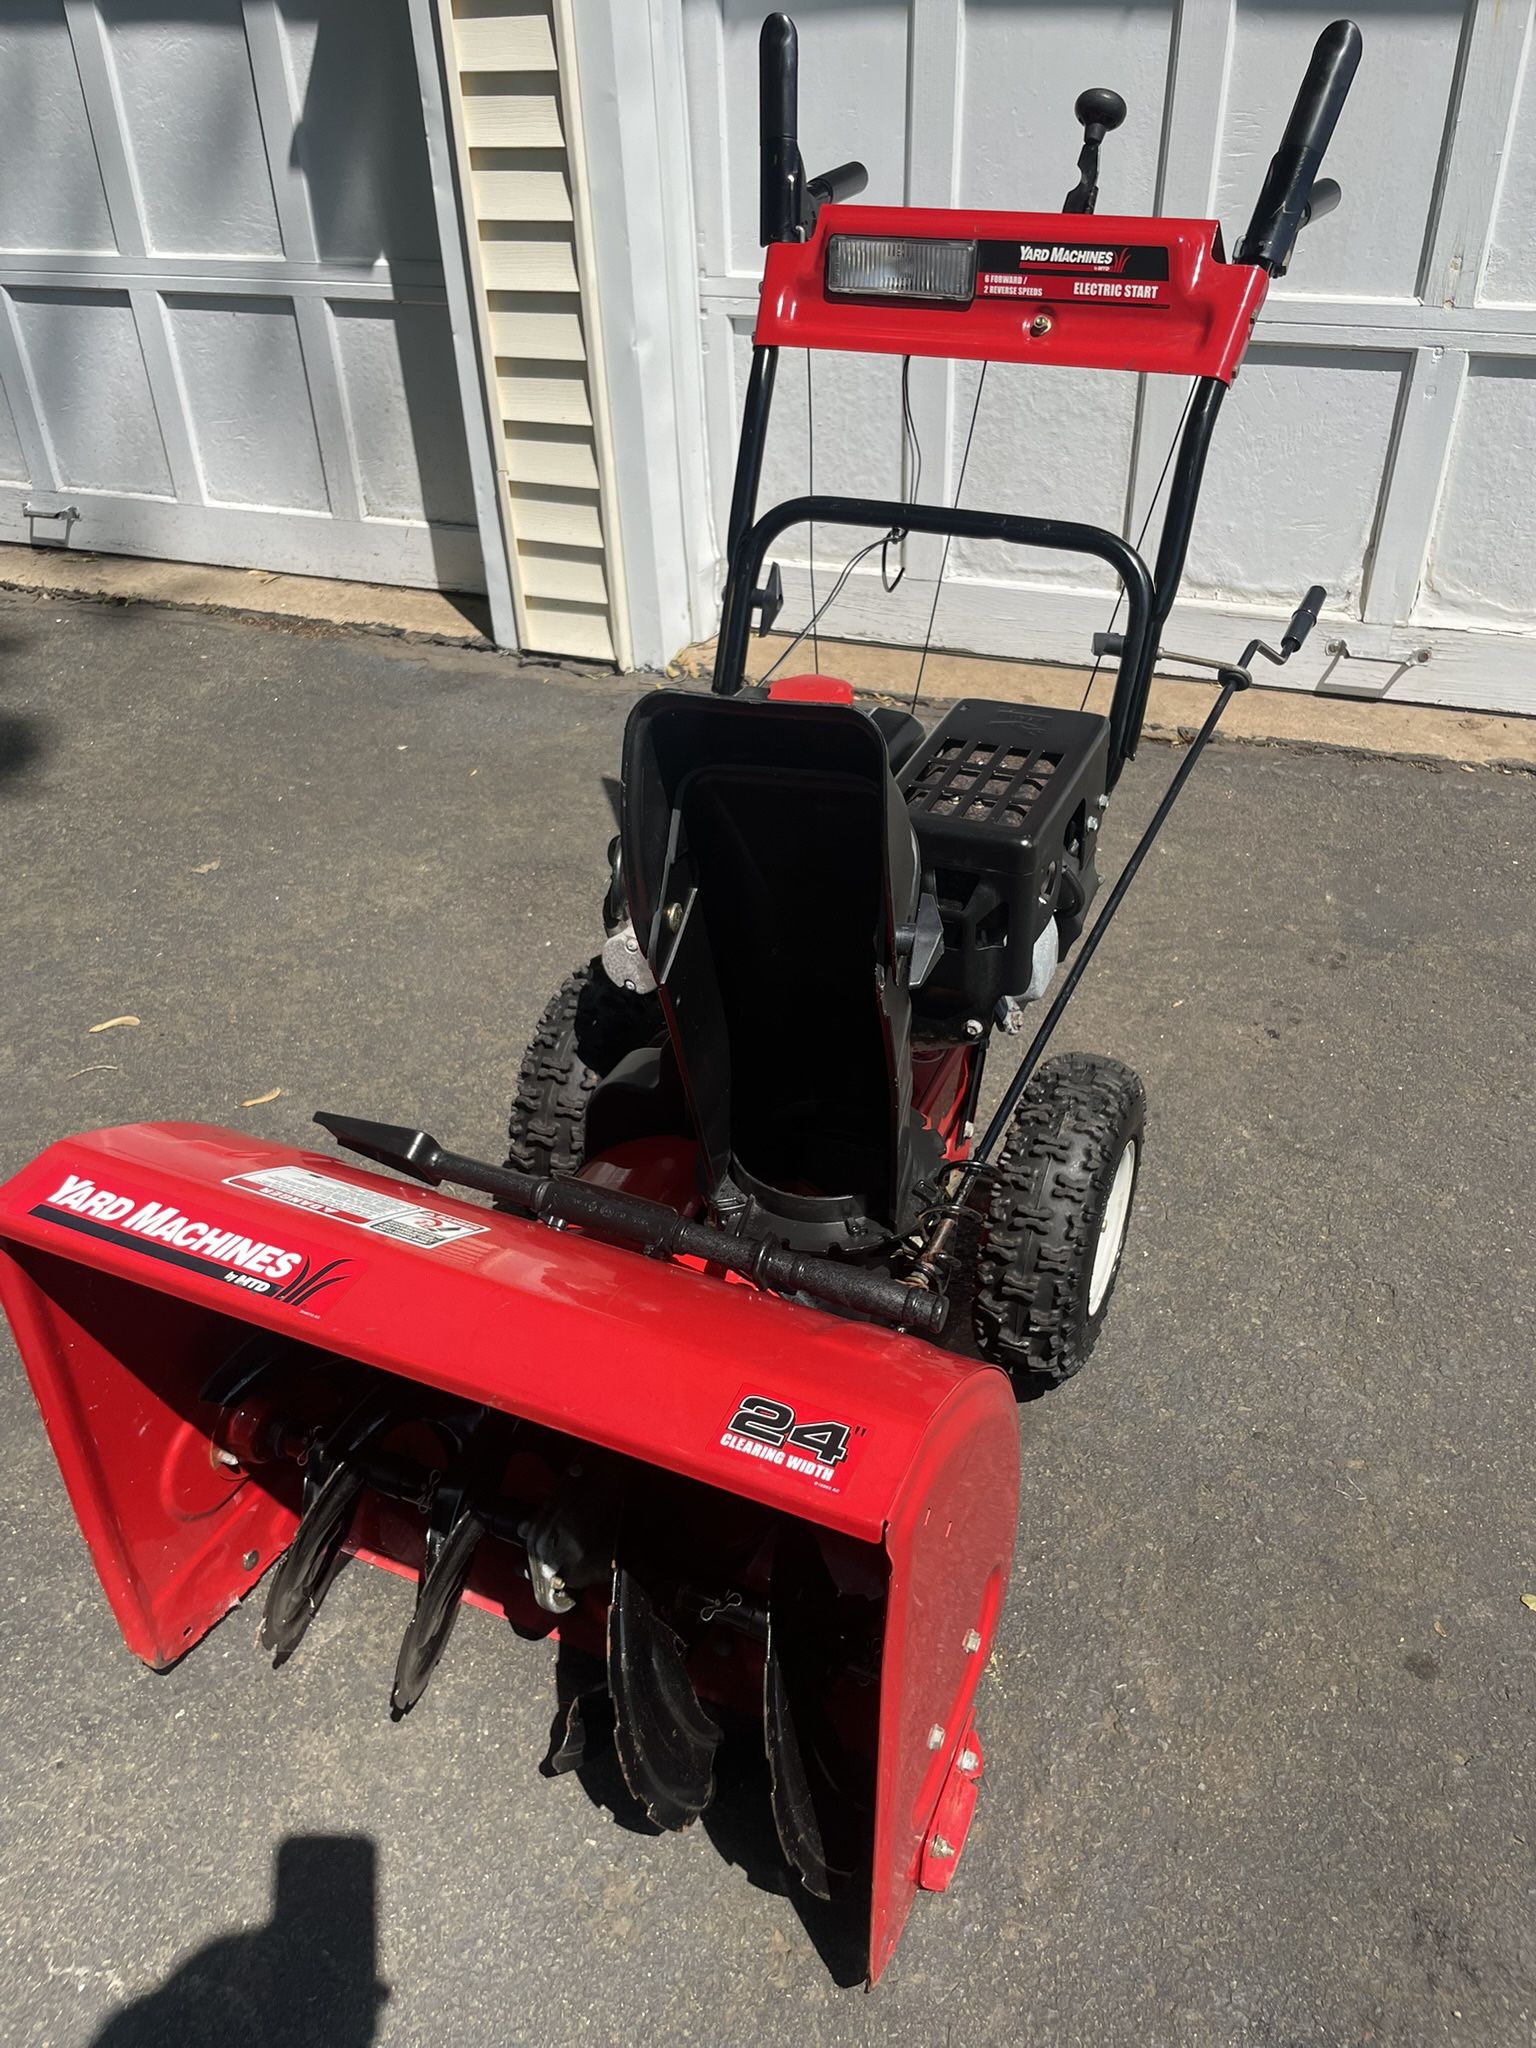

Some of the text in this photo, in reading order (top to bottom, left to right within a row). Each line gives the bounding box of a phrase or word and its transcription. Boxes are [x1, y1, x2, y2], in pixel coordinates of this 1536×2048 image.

[1019, 245, 1114, 265] YARD MACHINES
[984, 274, 990, 283] 6
[990, 275, 1023, 285] FORWARD
[1073, 282, 1159, 299] ELECTRIC START
[983, 285, 1043, 297] 2 REVERSE SPEEDS
[259, 1187, 326, 1212] DANGER
[47, 1174, 302, 1278] YARD MACHINES
[224, 1271, 271, 1293] by MTD
[727, 1394, 867, 1467] 24"
[720, 1433, 835, 1482] CLEARING WIDTH
